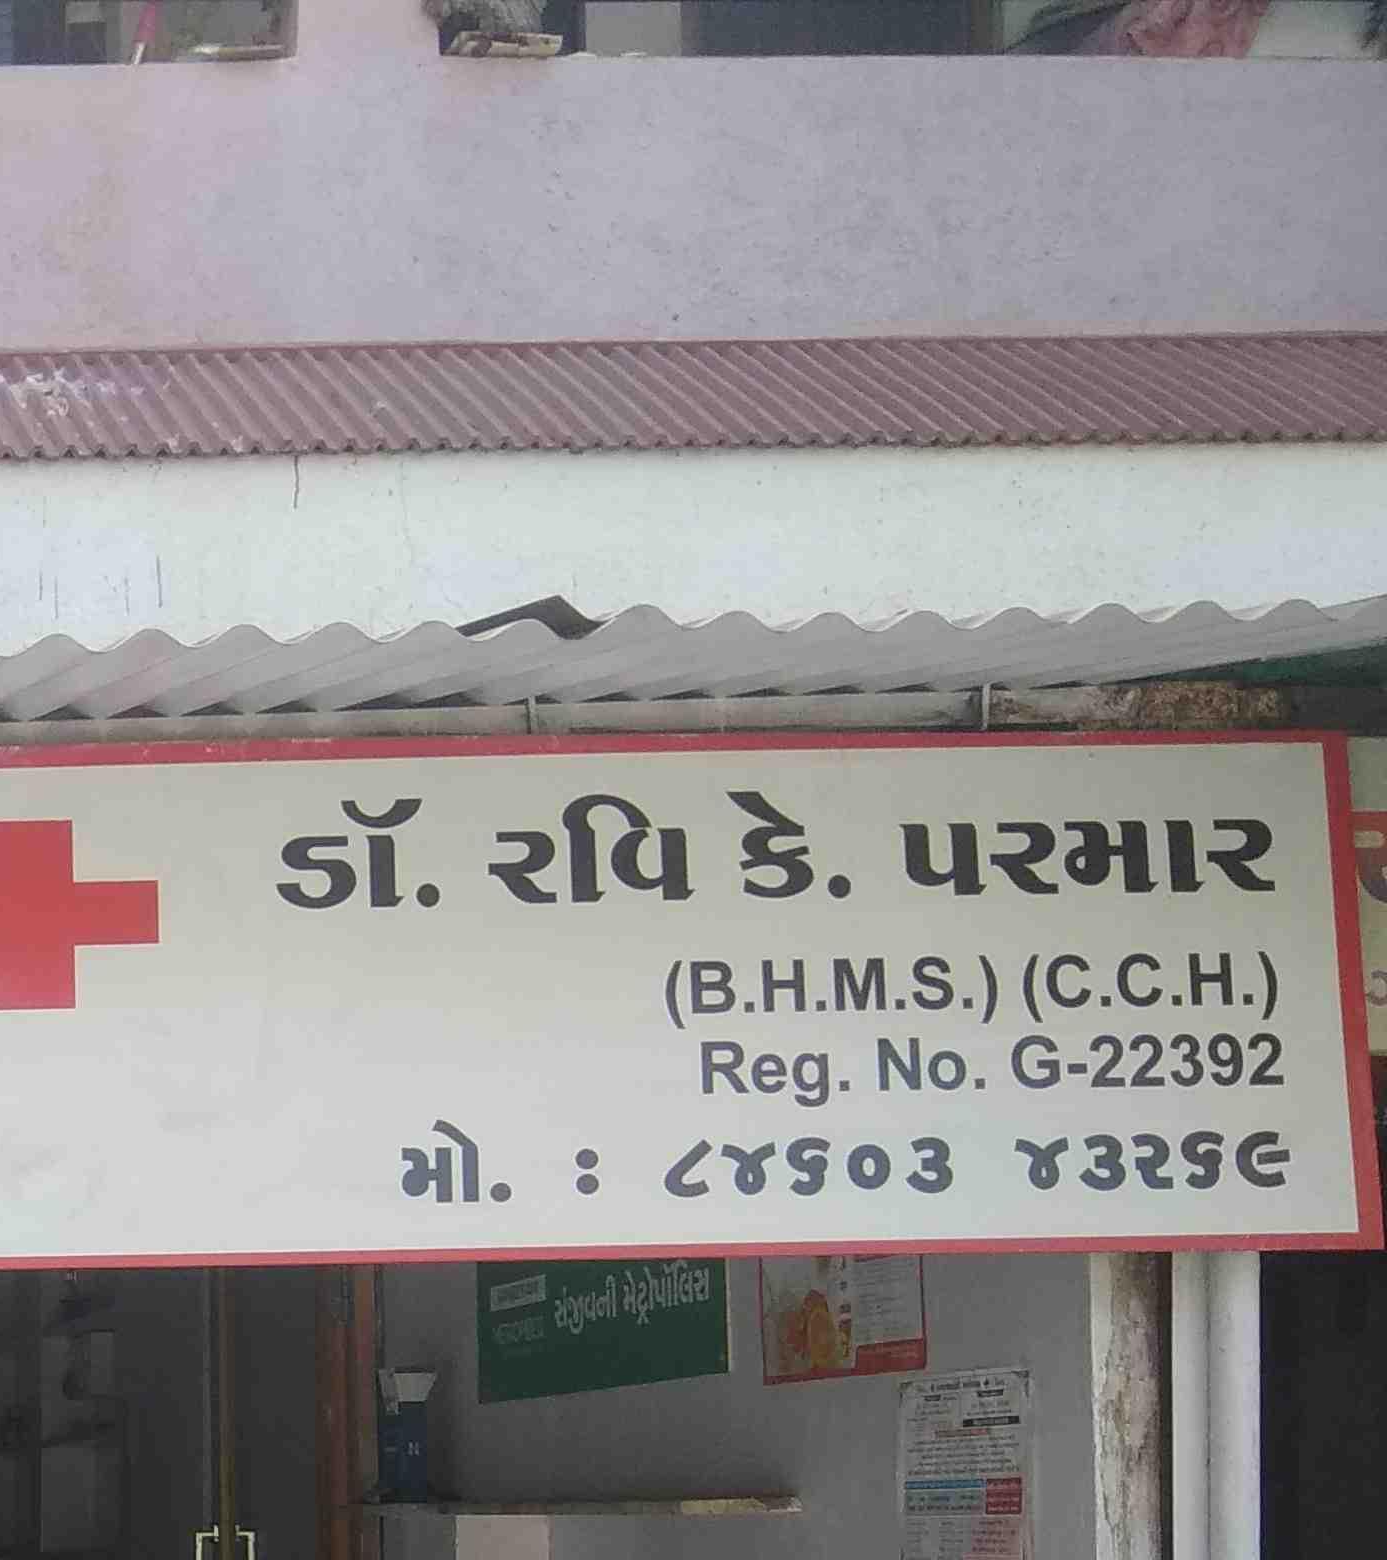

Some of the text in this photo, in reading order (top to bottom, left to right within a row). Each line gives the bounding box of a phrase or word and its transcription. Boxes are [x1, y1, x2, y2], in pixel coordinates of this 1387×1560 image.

[276, 797, 441, 910] ડૉ.
[487, 793, 696, 905] રવિ
[725, 790, 852, 899] કે.
[898, 818, 1276, 897] પરમાર
[665, 954, 998, 1030] (B.H.M.S.)
[1022, 950, 1278, 1024] (C.C.H.)
[700, 1032, 1285, 1105] Reg. No. G-22392
[401, 1119, 512, 1203] મો.
[664, 1136, 954, 1198] ૮૪૬૦૩
[1014, 1130, 1291, 1192] ૪૩૨૬૯
